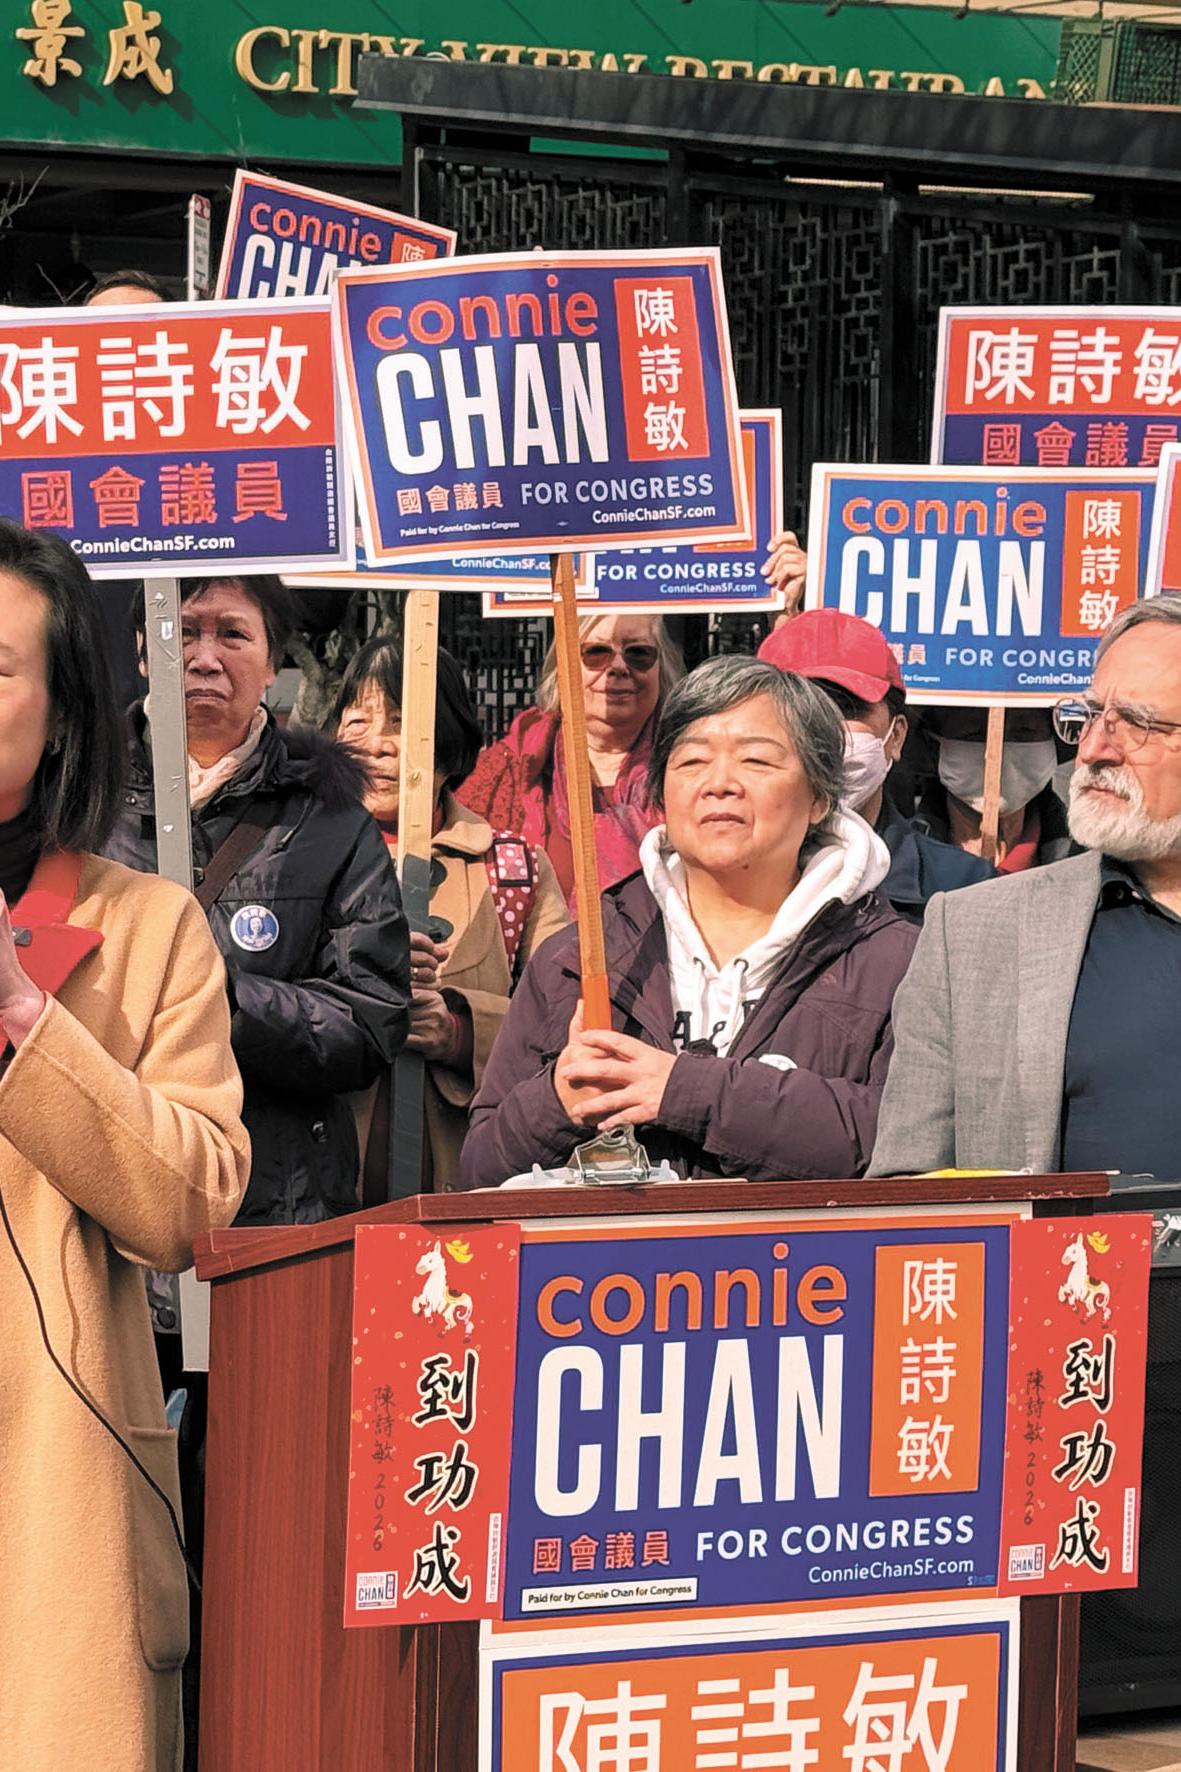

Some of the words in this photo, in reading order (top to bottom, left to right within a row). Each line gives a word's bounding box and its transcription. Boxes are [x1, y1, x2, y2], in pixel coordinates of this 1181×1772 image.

[249, 202, 382, 262] connie
[237, 233, 338, 299] CHA
[366, 274, 599, 352] connie
[633, 287, 689, 453] 陳詩敏
[964, 326, 1181, 407] 陳詩敏
[374, 341, 609, 475] CHAN
[982, 420, 1178, 467] 國會議員
[21, 461, 289, 529] 國會議員
[396, 481, 504, 516] 國會議員
[521, 483, 569, 505] FOR
[575, 473, 714, 503] CONGRESS
[592, 504, 716, 524] ConnieChanSF.com
[842, 486, 1048, 538] connie
[70, 534, 236, 555] ConnieChanSF.com
[451, 556, 552, 570] ConnieChanSF.co
[597, 564, 638, 581] FOR
[643, 562, 757, 580] CONGRESS
[1077, 499, 1122, 631] 陳詩敏
[659, 582, 757, 594] ConnieChanSF.com
[837, 536, 1047, 638] CHAN
[946, 648, 994, 666] FOR
[1002, 650, 1094, 667] CONGR
[1017, 673, 1095, 685] ConnieChan
[537, 1241, 848, 1338] connie
[896, 1256, 959, 1483] 陳詩敏
[371, 1383, 396, 1465] 陳詩敏
[534, 1333, 845, 1518] CHAN
[1049, 1334, 1116, 1573] 到功成
[404, 1350, 479, 1601] 到功成
[1023, 1452, 1036, 1526] 2026
[372, 1472, 386, 1552] 2026
[696, 1528, 768, 1562] FOR
[781, 1514, 975, 1555] CONGRESS
[532, 1530, 671, 1575] 國會議員
[808, 1557, 974, 1584] ConnieChanSF.com
[1010, 1559, 1033, 1573] CHAN
[358, 1586, 384, 1601] CHAN
[528, 1593, 548, 1604] Paid
[549, 1592, 563, 1602] for
[564, 1592, 576, 1602] by
[577, 1589, 609, 1601] Connie
[610, 1588, 634, 1598] Chan
[635, 1587, 649, 1597] for
[650, 1585, 692, 1597] Congress
[539, 1656, 969, 1772] 陳詩敏
